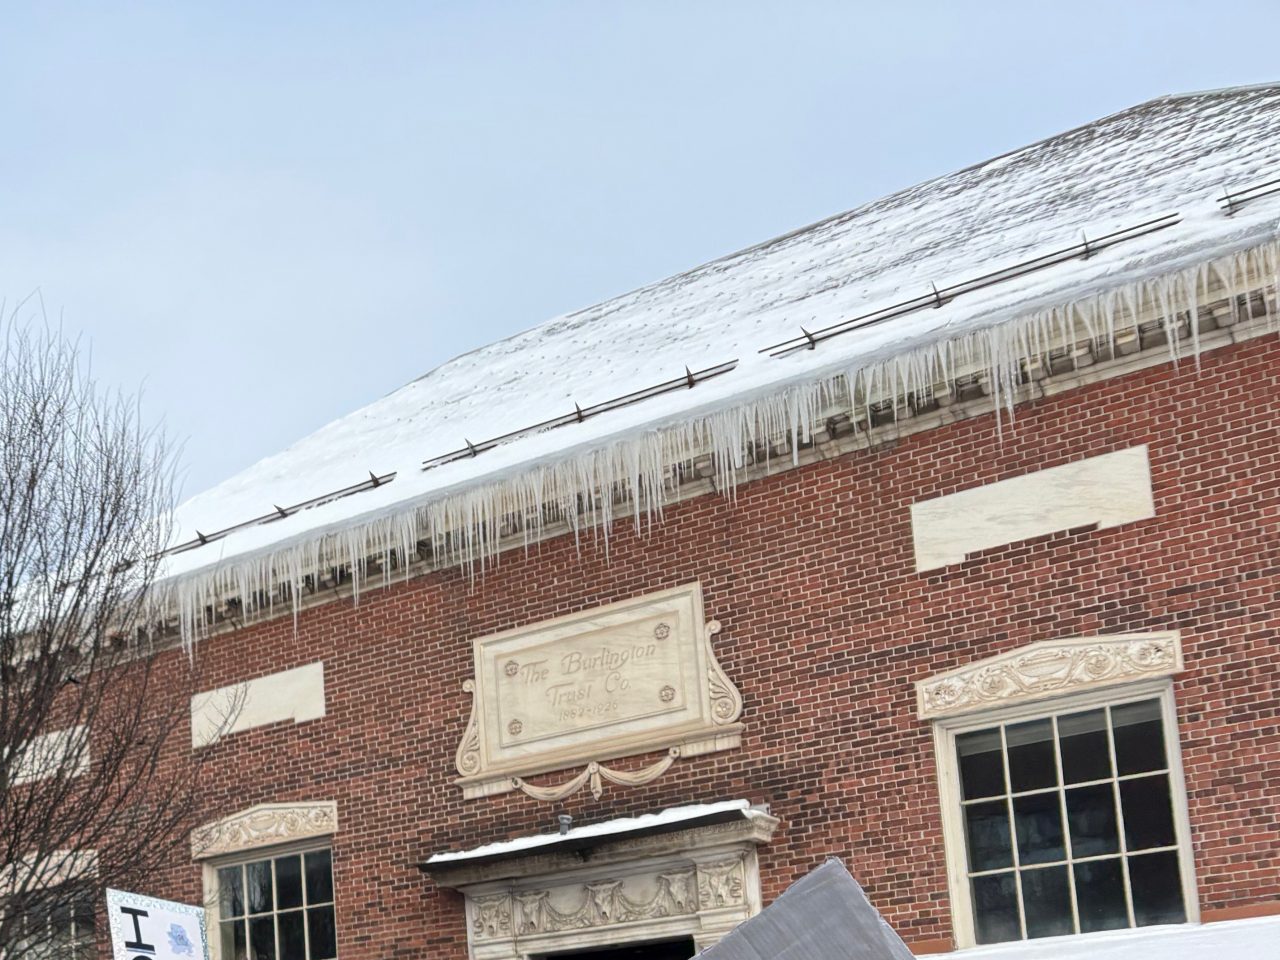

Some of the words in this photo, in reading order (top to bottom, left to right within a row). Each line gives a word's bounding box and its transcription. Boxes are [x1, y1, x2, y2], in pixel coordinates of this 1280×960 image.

[520, 658, 550, 684] The
[561, 644, 656, 676] Burlington
[545, 680, 595, 706] Trust
[605, 671, 632, 693] Co.
[121, 906, 156, 951] I
